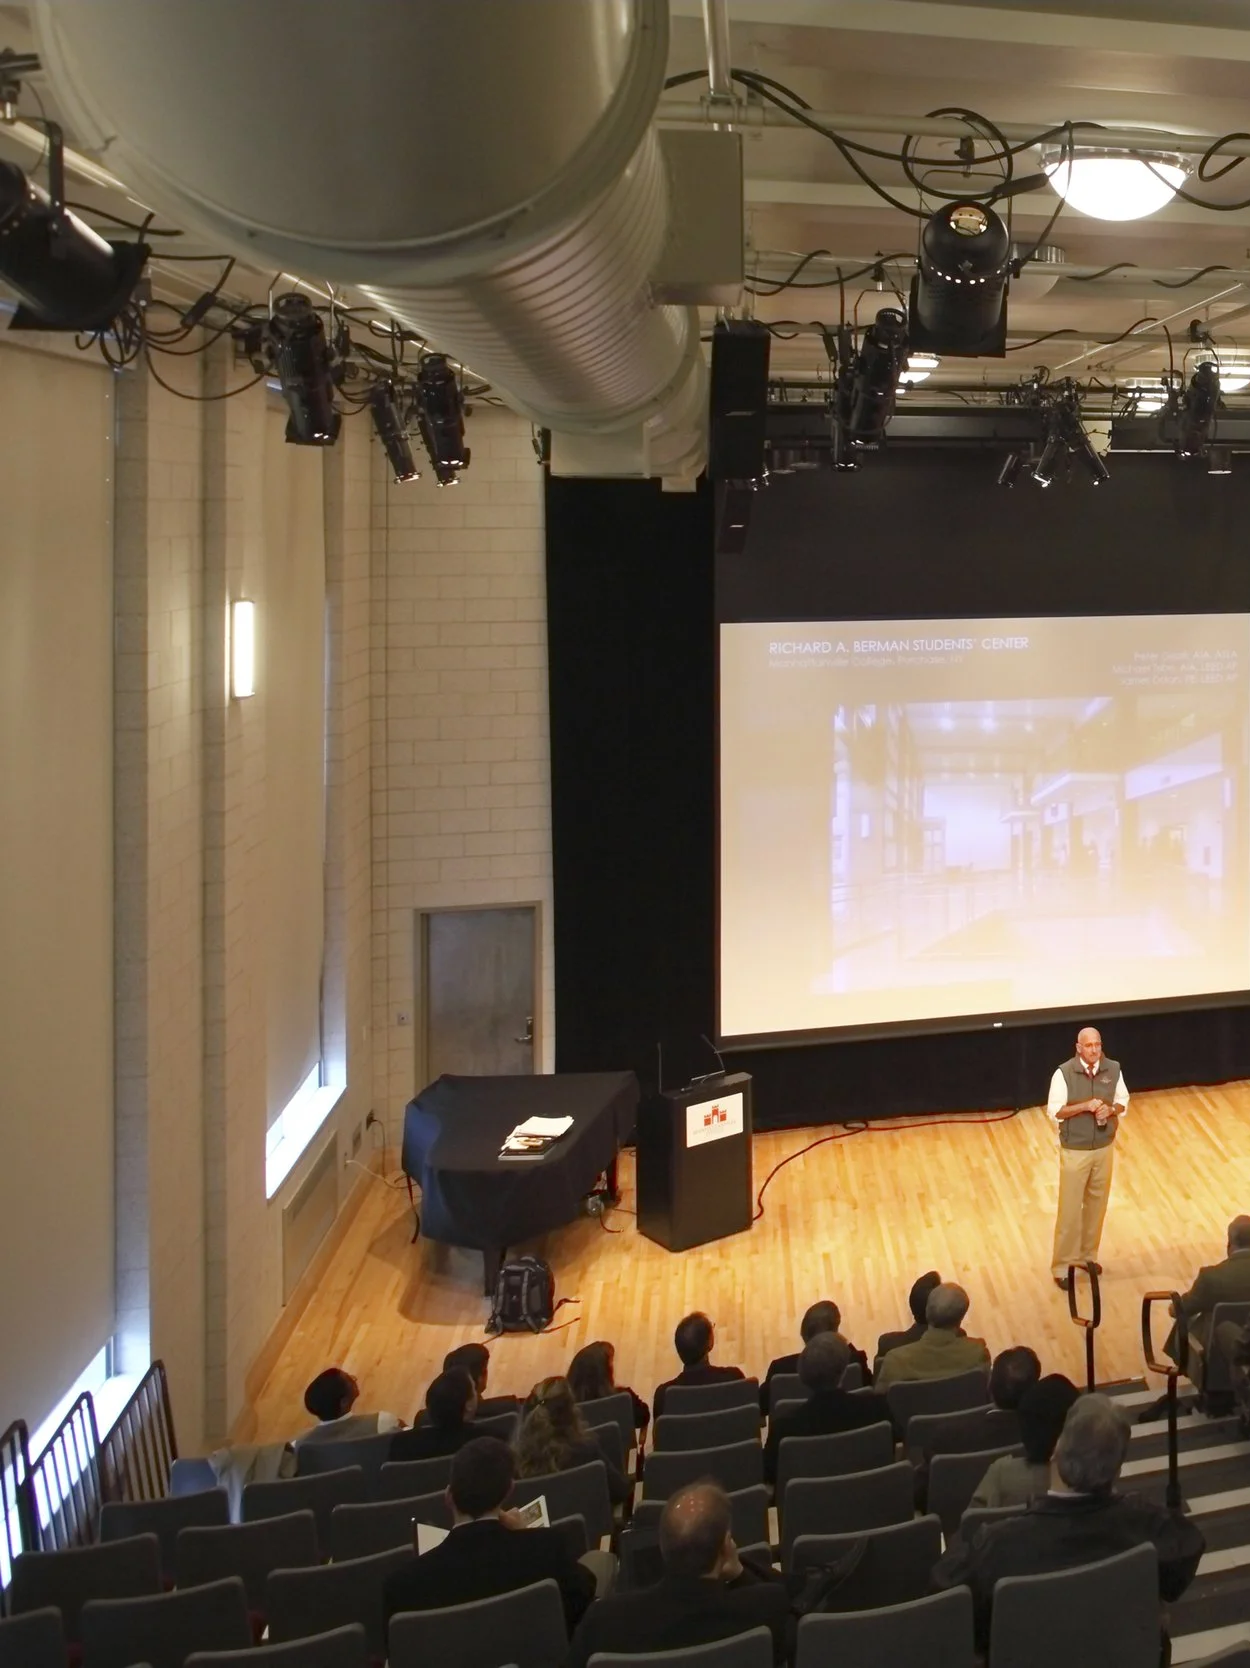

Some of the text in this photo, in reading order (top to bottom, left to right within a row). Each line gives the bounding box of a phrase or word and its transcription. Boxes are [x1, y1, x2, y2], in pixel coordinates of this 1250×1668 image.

[769, 641, 832, 655] RICHARD
[835, 641, 850, 654] A.
[853, 639, 910, 653] BERMAN
[981, 636, 1030, 650] CENTER
